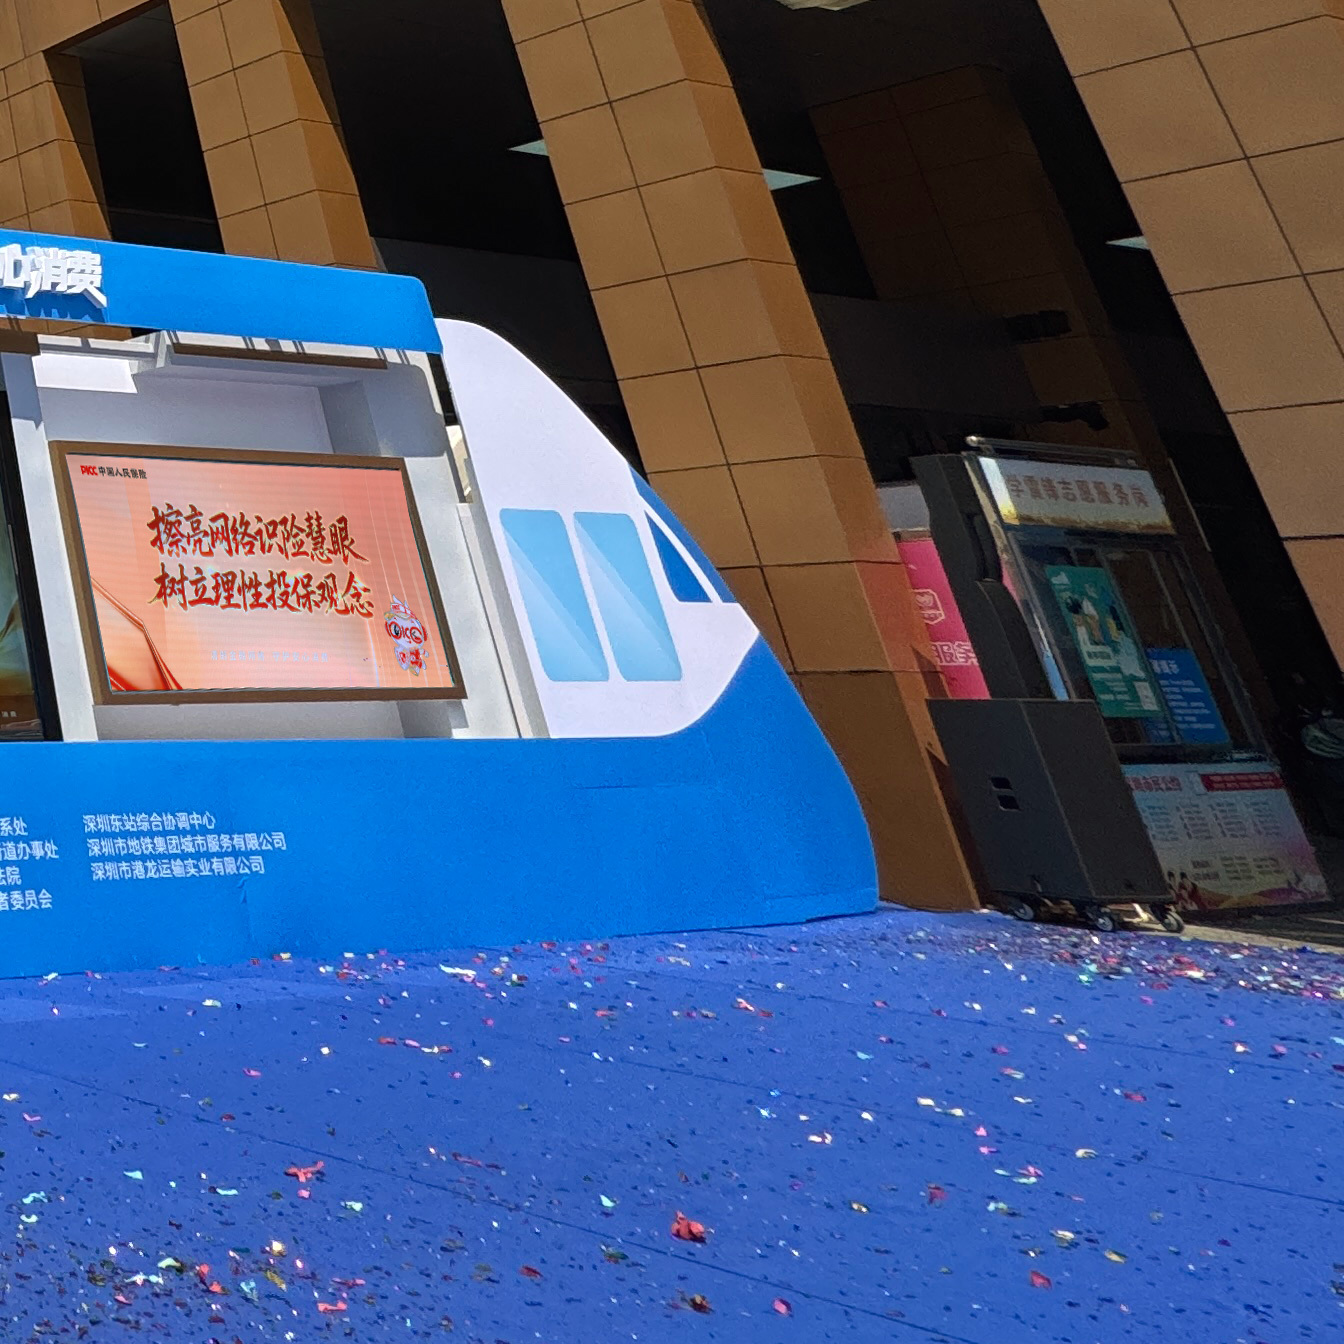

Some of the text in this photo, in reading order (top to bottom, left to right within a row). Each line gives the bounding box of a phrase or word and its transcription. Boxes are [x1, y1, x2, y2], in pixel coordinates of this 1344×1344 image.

[80, 464, 148, 480] PICC 中国人民保险
[147, 503, 370, 566] 擦亮网络识险慧眼
[147, 562, 375, 619] 树立理性投保观念
